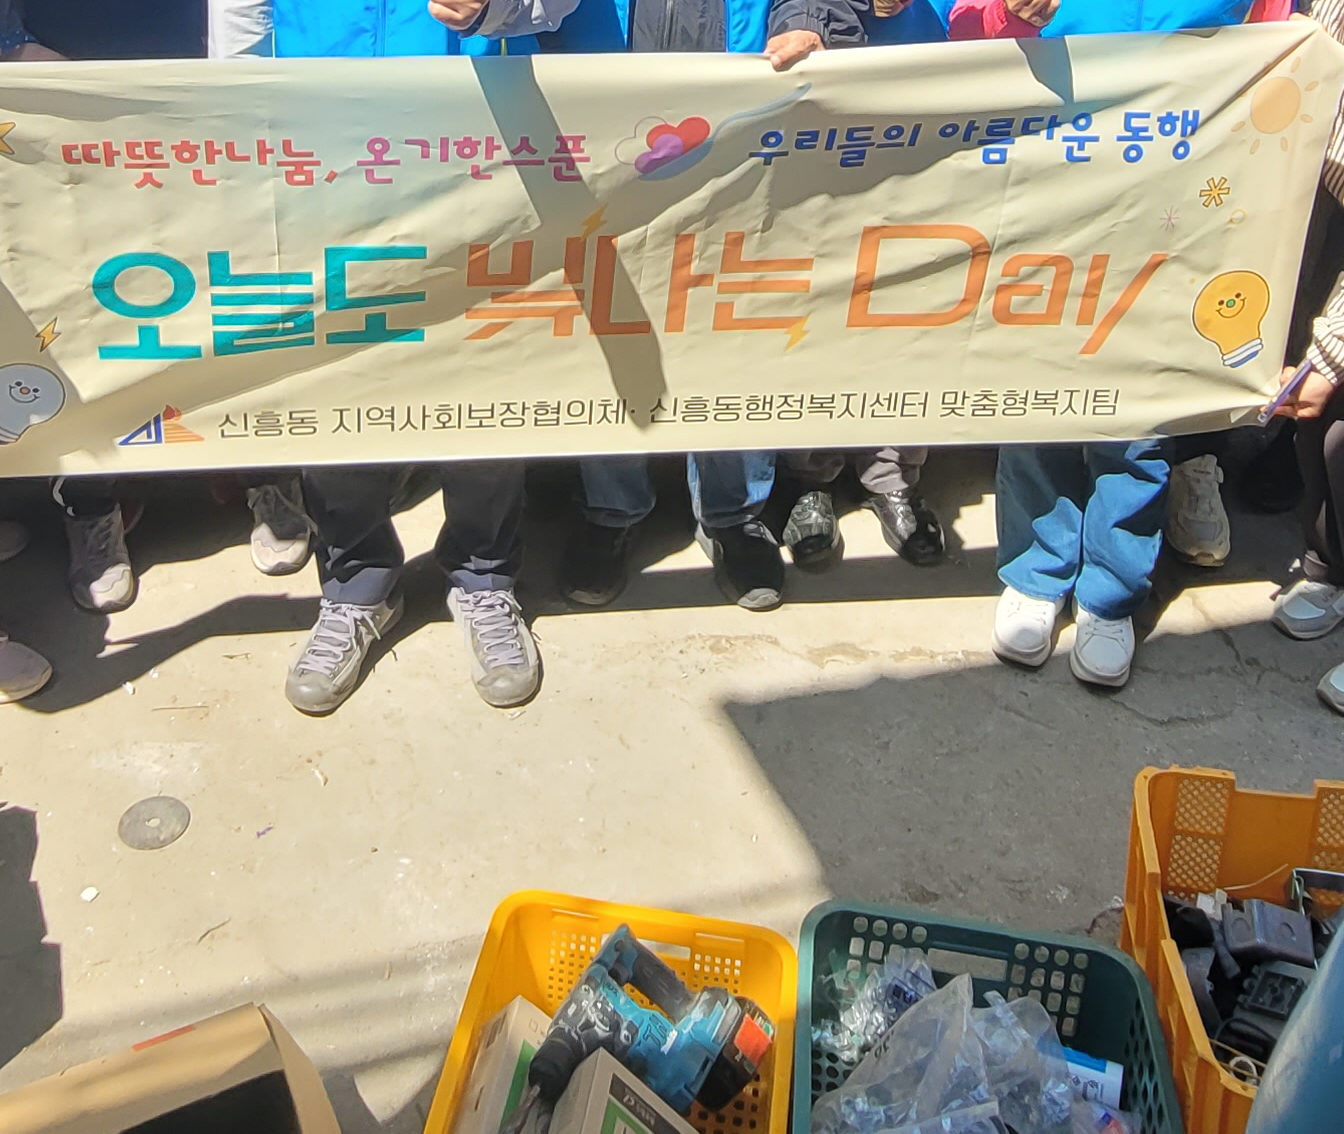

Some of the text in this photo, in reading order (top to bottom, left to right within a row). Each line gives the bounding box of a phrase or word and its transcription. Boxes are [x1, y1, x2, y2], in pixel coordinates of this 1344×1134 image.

[61, 134, 592, 189] 따뜻한나눔, 온기한스푼
[748, 108, 1201, 168] 우리들의 아름다운 동행
[91, 224, 1170, 362] 오늘도 빛나는 Day
[217, 408, 320, 440] 신흥동
[648, 389, 930, 425] 신흥동행정복지센터
[938, 387, 1122, 418] 맞춤형복지팀
